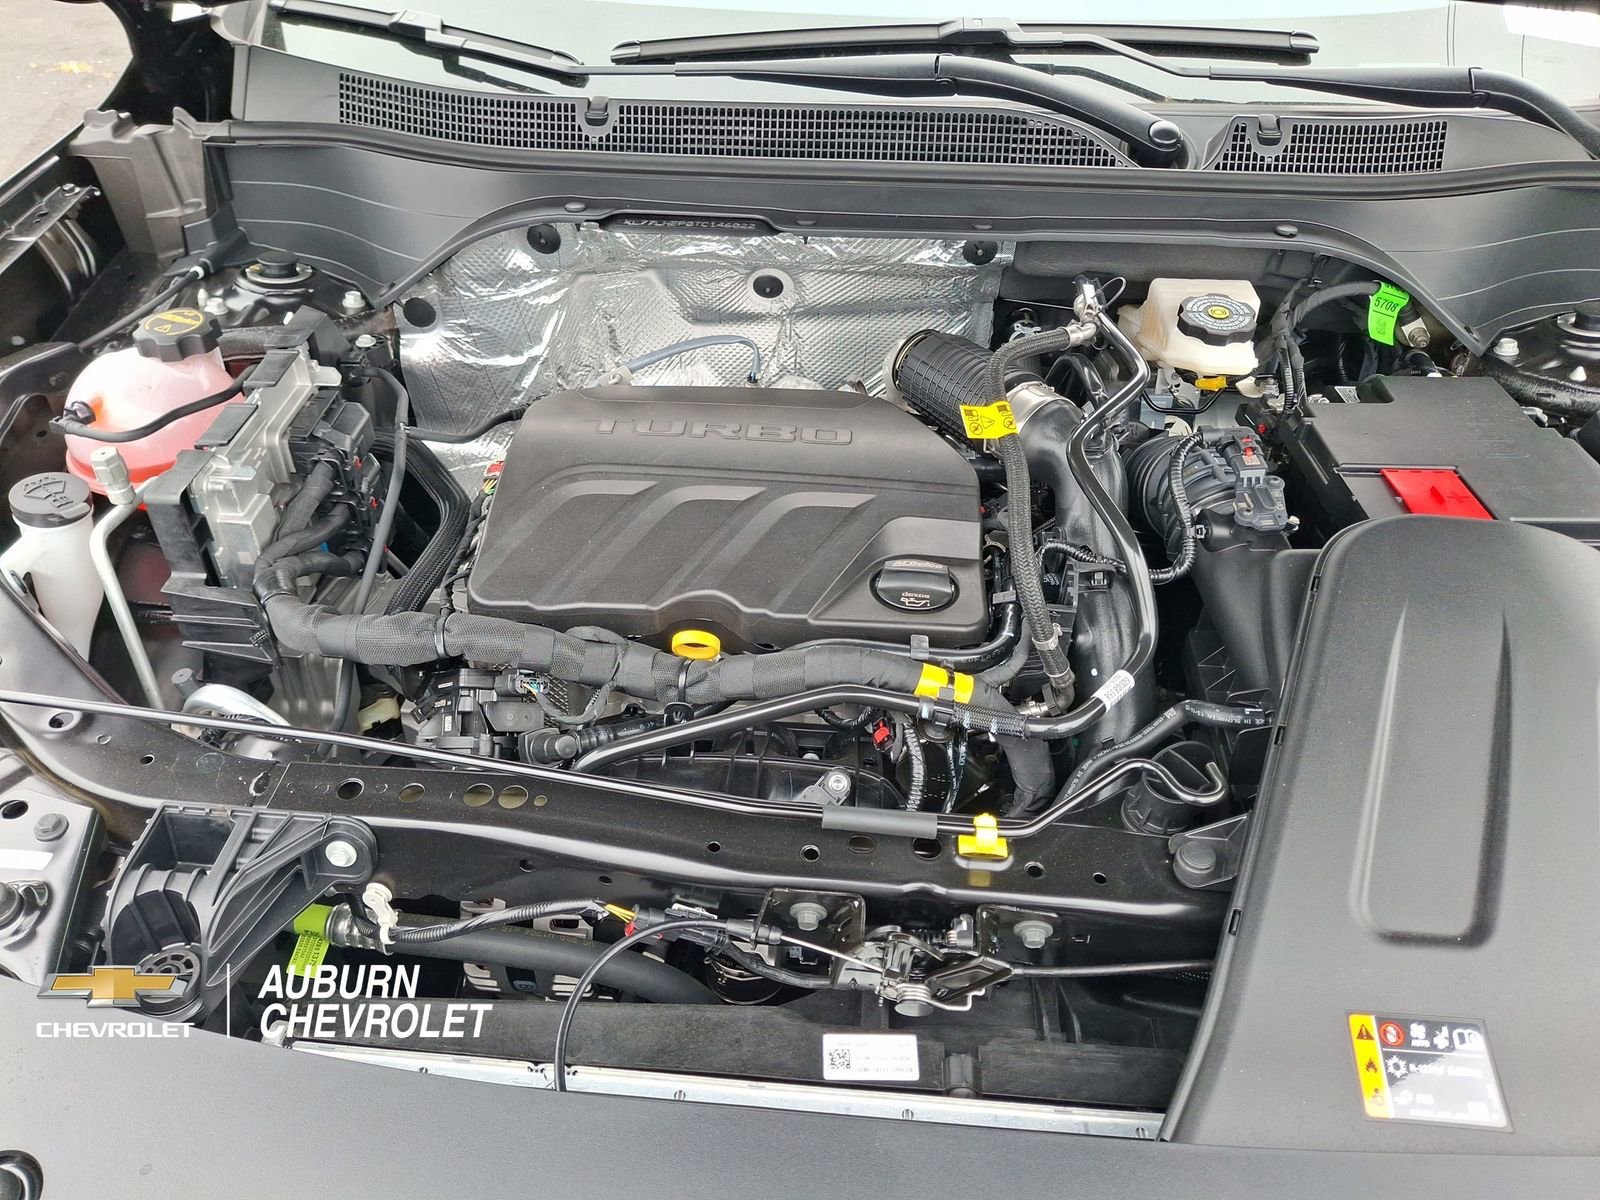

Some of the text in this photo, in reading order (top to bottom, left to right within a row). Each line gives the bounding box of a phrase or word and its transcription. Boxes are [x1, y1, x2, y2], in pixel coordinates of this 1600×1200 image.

[1374, 296, 1400, 312] 5708
[584, 418, 853, 445] TURBO
[901, 591, 930, 599] dexos
